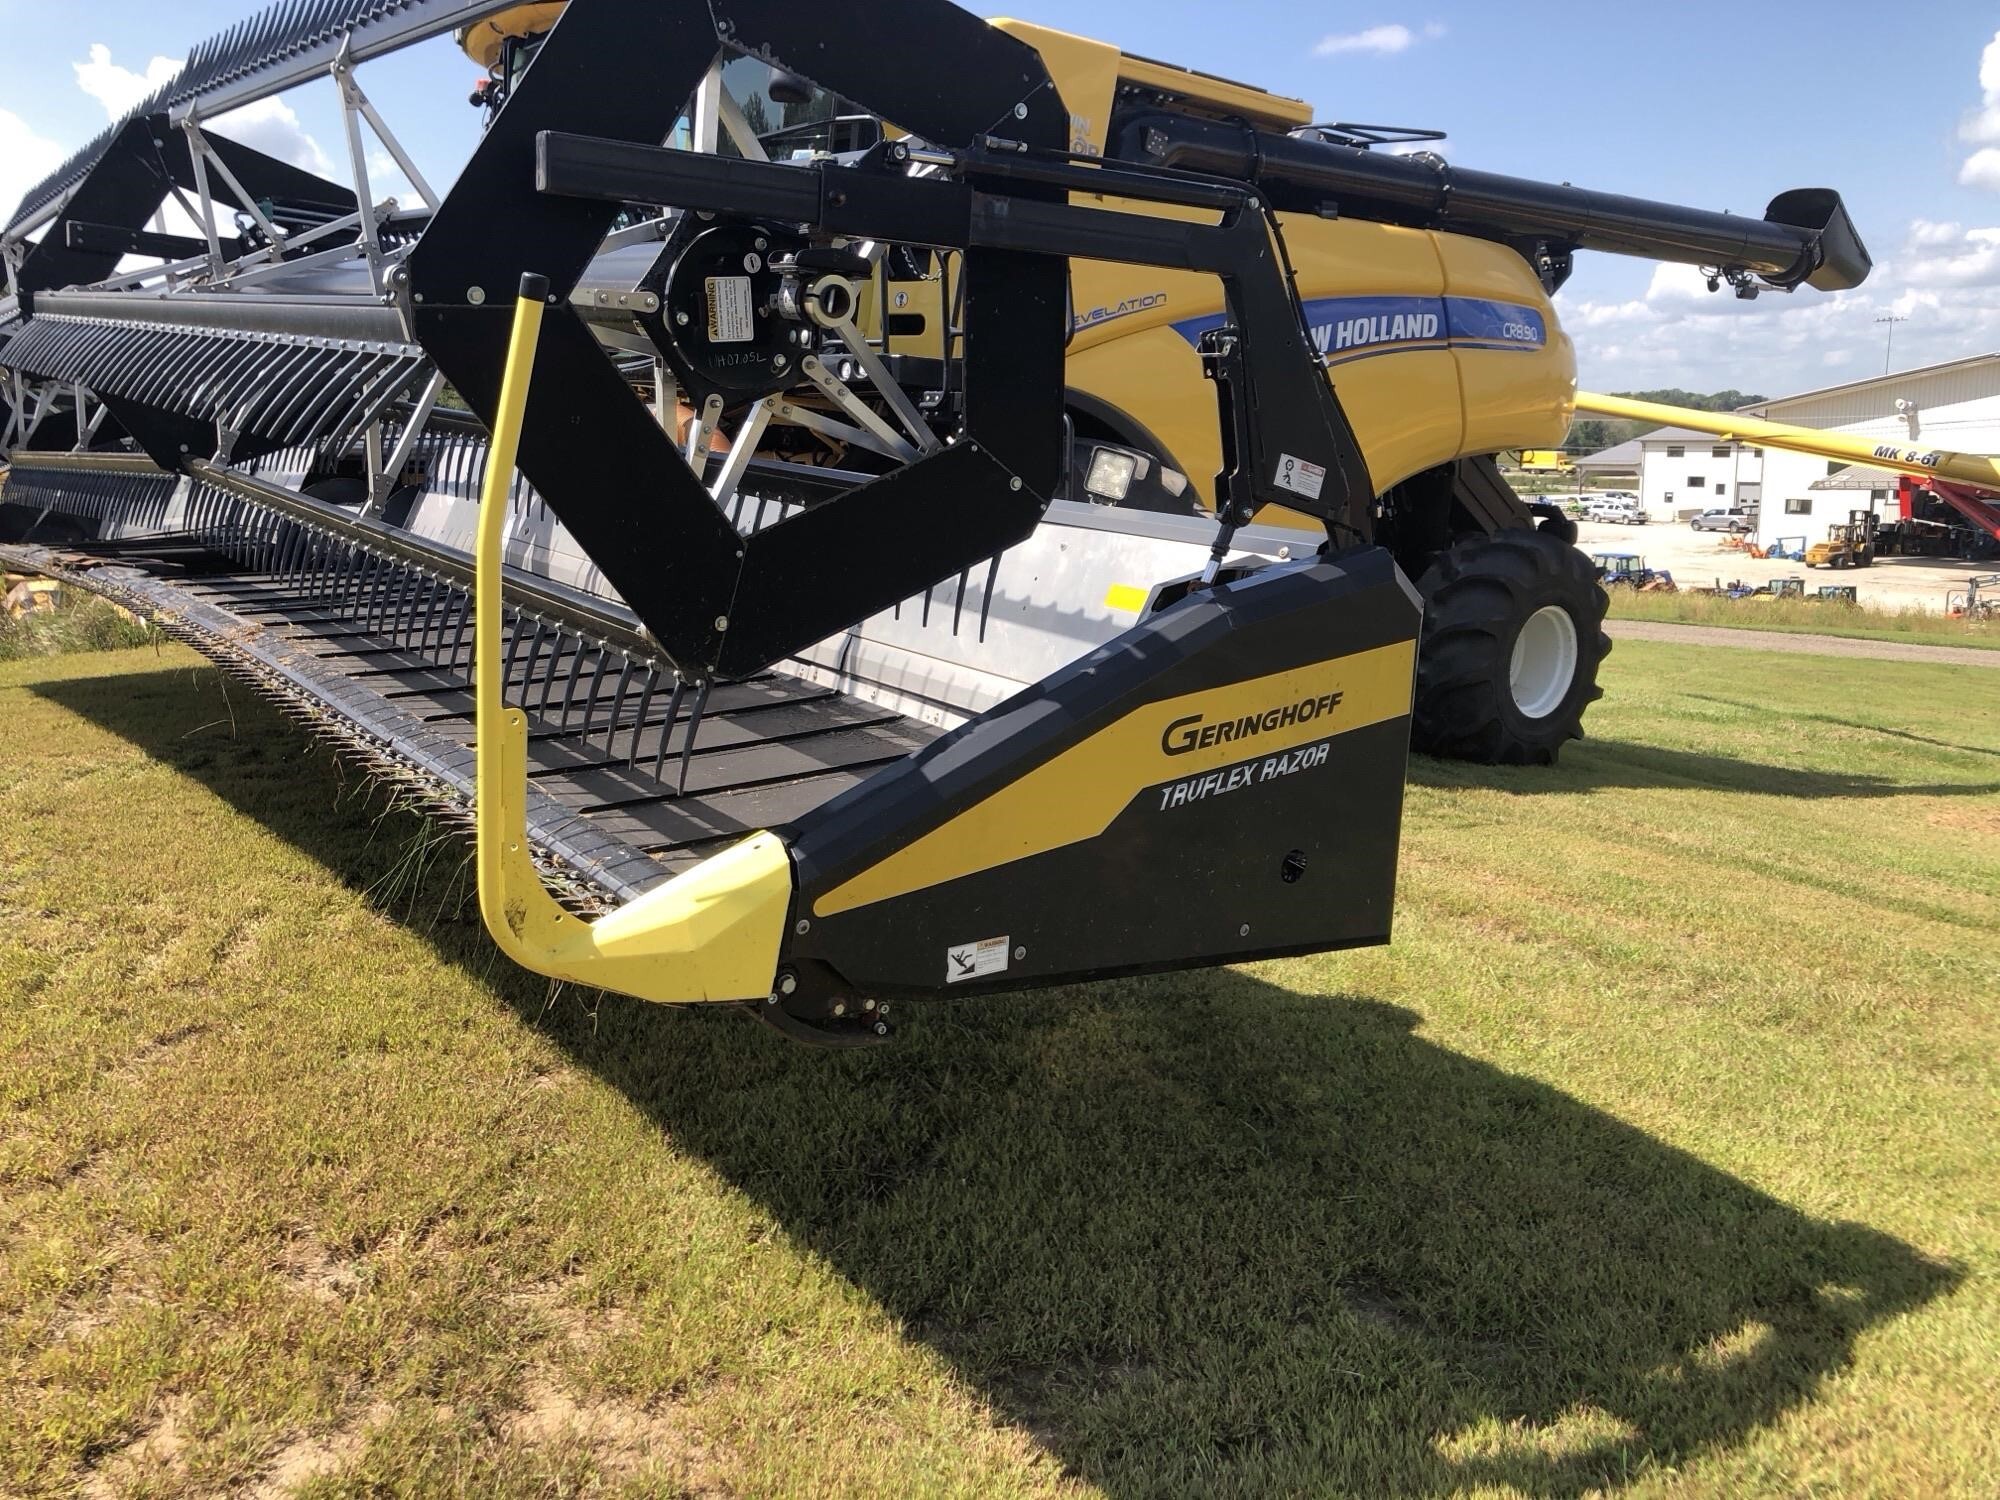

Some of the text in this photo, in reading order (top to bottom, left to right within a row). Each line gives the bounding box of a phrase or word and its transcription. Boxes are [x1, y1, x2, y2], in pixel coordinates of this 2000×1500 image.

[707, 282, 718, 329] WARNING
[1073, 293, 1167, 325] EVELATION
[1336, 313, 1438, 349] HOLLAND
[1874, 446, 1940, 467] MK 8-61
[1161, 691, 1345, 757] GERINGHOFF
[1160, 743, 1331, 811] TRUFLEX RAZOR
